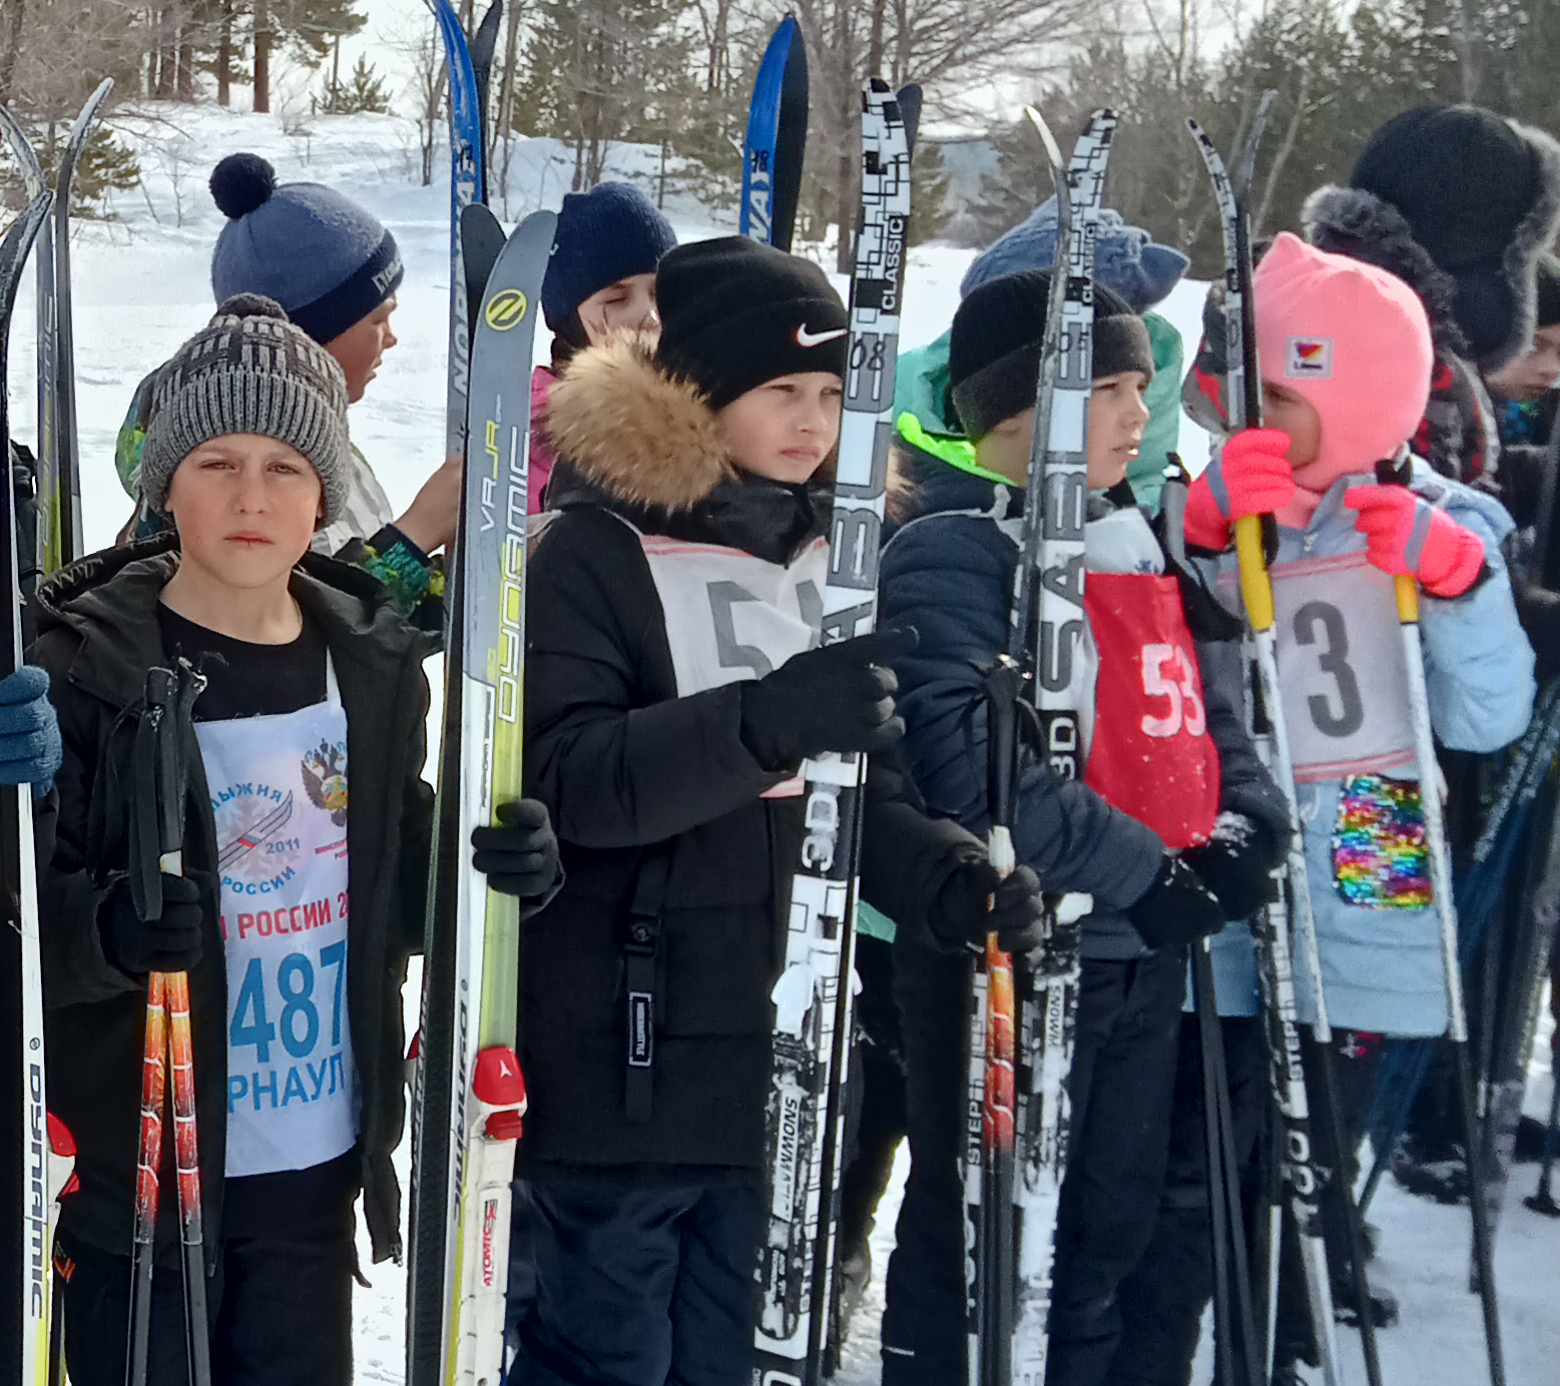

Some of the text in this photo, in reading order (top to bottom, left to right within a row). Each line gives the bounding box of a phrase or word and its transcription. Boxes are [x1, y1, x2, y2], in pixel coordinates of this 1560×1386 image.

[881, 216, 904, 311] CLASSIC
[821, 331, 898, 647] ABLE
[498, 425, 530, 724] DYNAMIC
[1141, 643, 1206, 738] 53
[1048, 715, 1078, 782] 3D
[221, 865, 295, 895] РОССИИ
[265, 837, 300, 855] 2011
[238, 898, 332, 939] РОССИИ
[230, 939, 346, 1063] 487
[967, 1104, 983, 1166] STEP
[28, 1063, 44, 1318] DYNAMIC
[483, 1222, 494, 1287] ATOMIC
